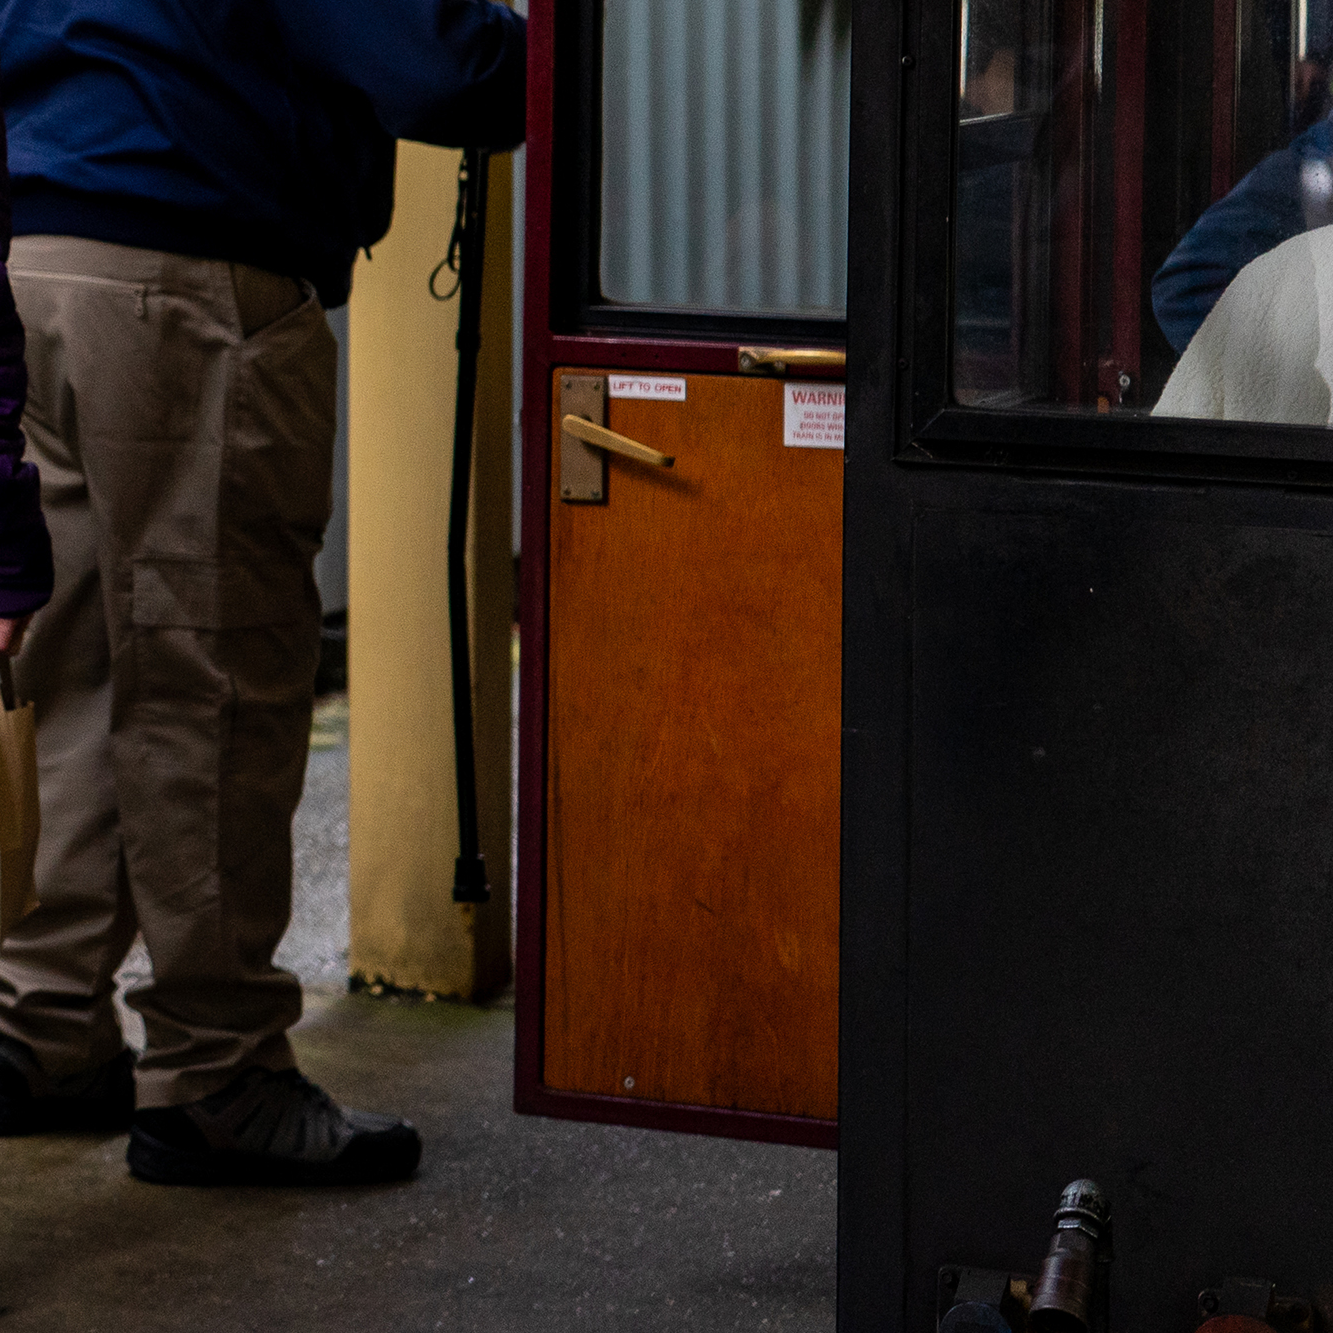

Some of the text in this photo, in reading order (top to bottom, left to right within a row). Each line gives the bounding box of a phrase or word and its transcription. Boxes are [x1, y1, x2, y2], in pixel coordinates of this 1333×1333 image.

[613, 381, 682, 393] LIFT TO OPEN
[792, 390, 845, 405] WARNI
